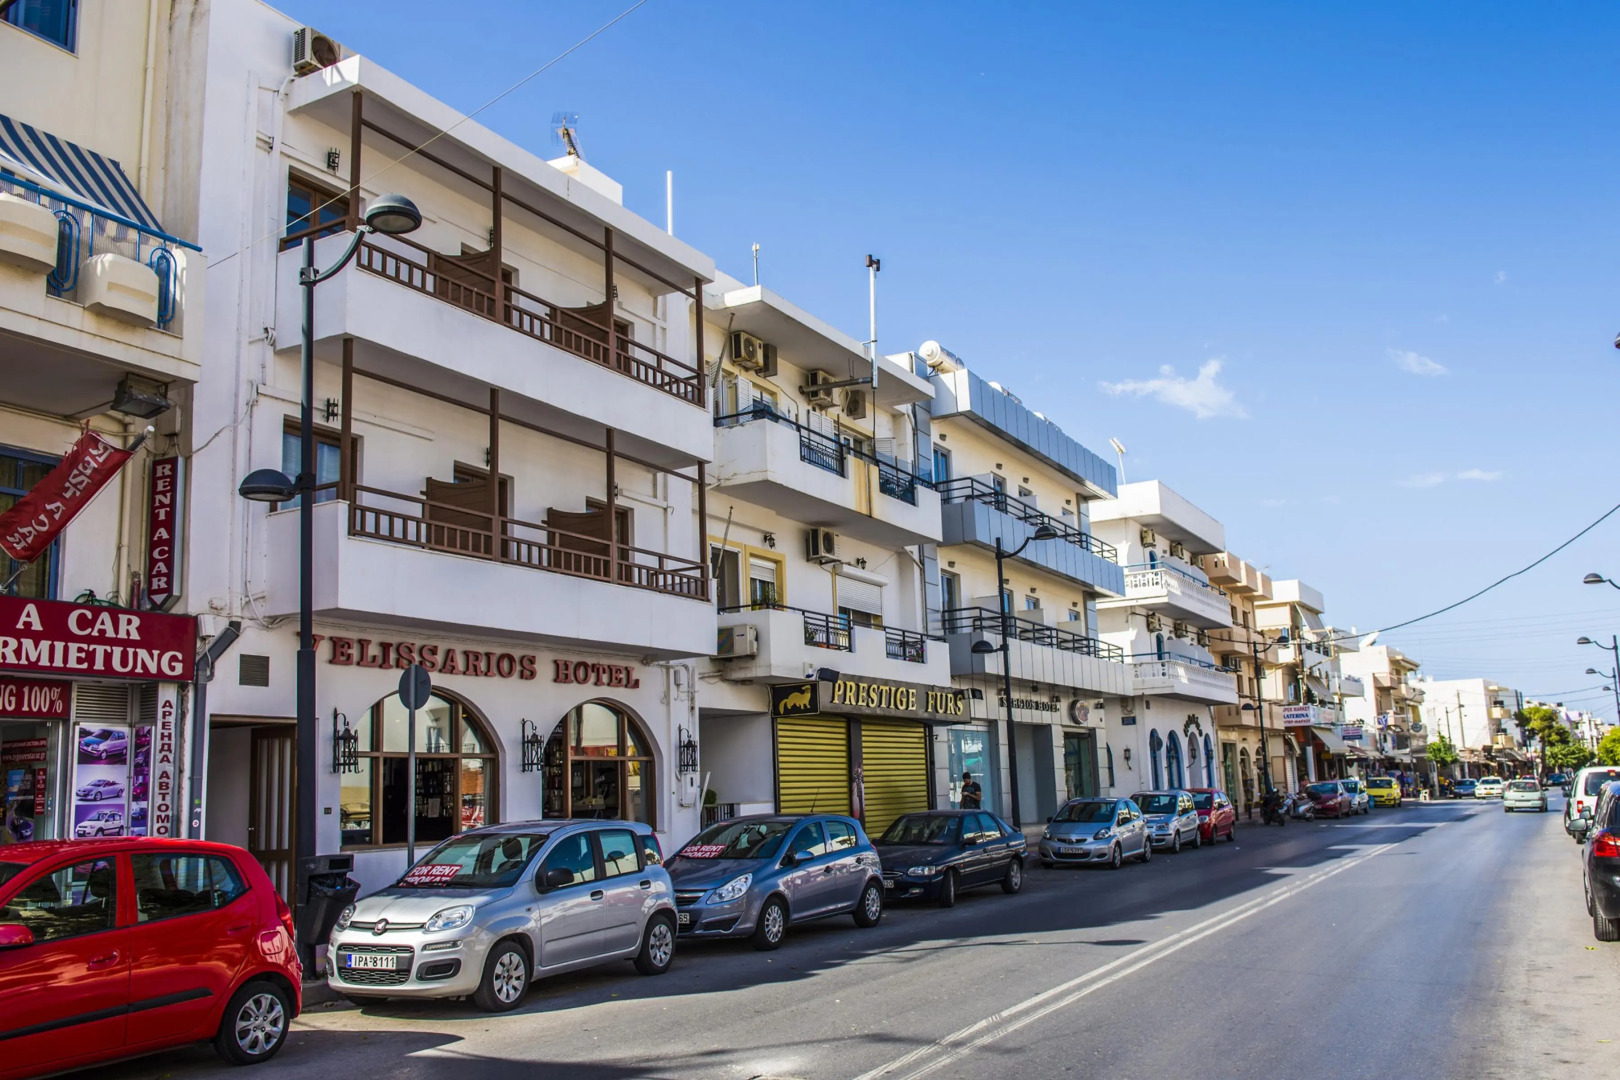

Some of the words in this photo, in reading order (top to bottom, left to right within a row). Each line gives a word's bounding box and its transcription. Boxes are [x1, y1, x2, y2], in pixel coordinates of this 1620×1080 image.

[153, 464, 173, 521] RENT
[153, 527, 170, 541] A
[151, 546, 169, 590] CAR
[16, 603, 43, 631] A
[67, 609, 141, 641] CAR
[0, 636, 183, 676] RMIETUNG
[553, 658, 640, 689] HOTEL
[22, 686, 63, 713] 100%
[832, 680, 917, 711] PRESTIGE
[926, 691, 963, 716] FURS
[1001, 697, 1036, 710] SRGIOS
[159, 700, 173, 764] АРЕНДА
[156, 770, 170, 835] АВТОМО
[409, 866, 432, 876] FOR
[430, 865, 460, 875] RENT
